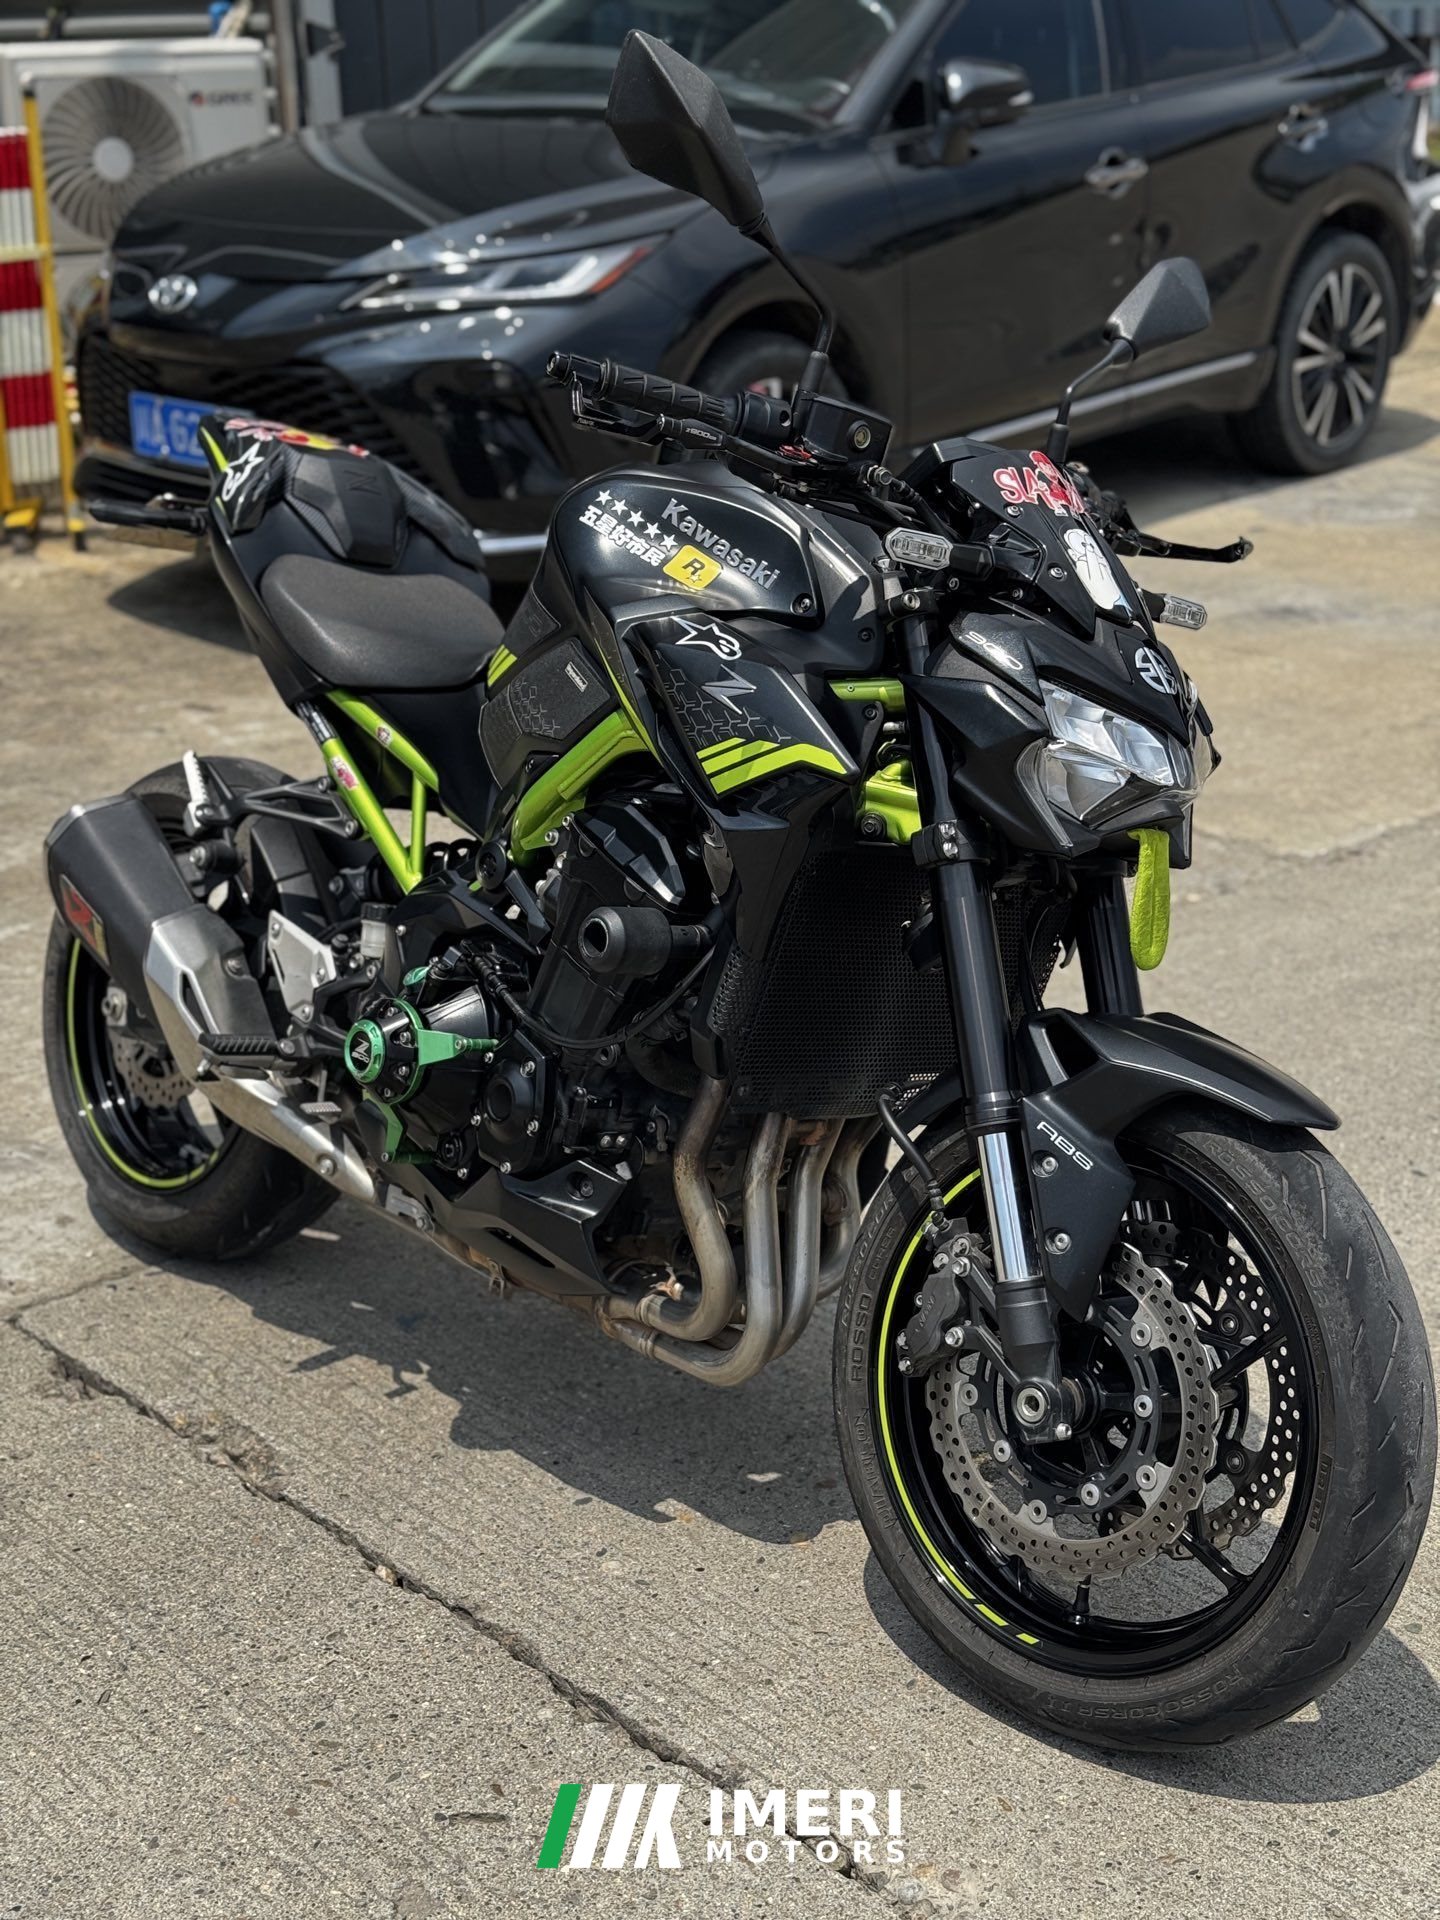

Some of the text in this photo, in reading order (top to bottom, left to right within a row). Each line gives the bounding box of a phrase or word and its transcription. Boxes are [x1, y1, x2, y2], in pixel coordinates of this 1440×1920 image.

[579, 504, 666, 567] 五星好市民
[661, 498, 781, 590] Kawasaki
[1036, 1121, 1094, 1171] ABS
[1202, 1138, 1278, 1212] ROSSO
[850, 1225, 897, 1382] ROSSO CORSA
[1166, 1662, 1244, 1714] ROSSO
